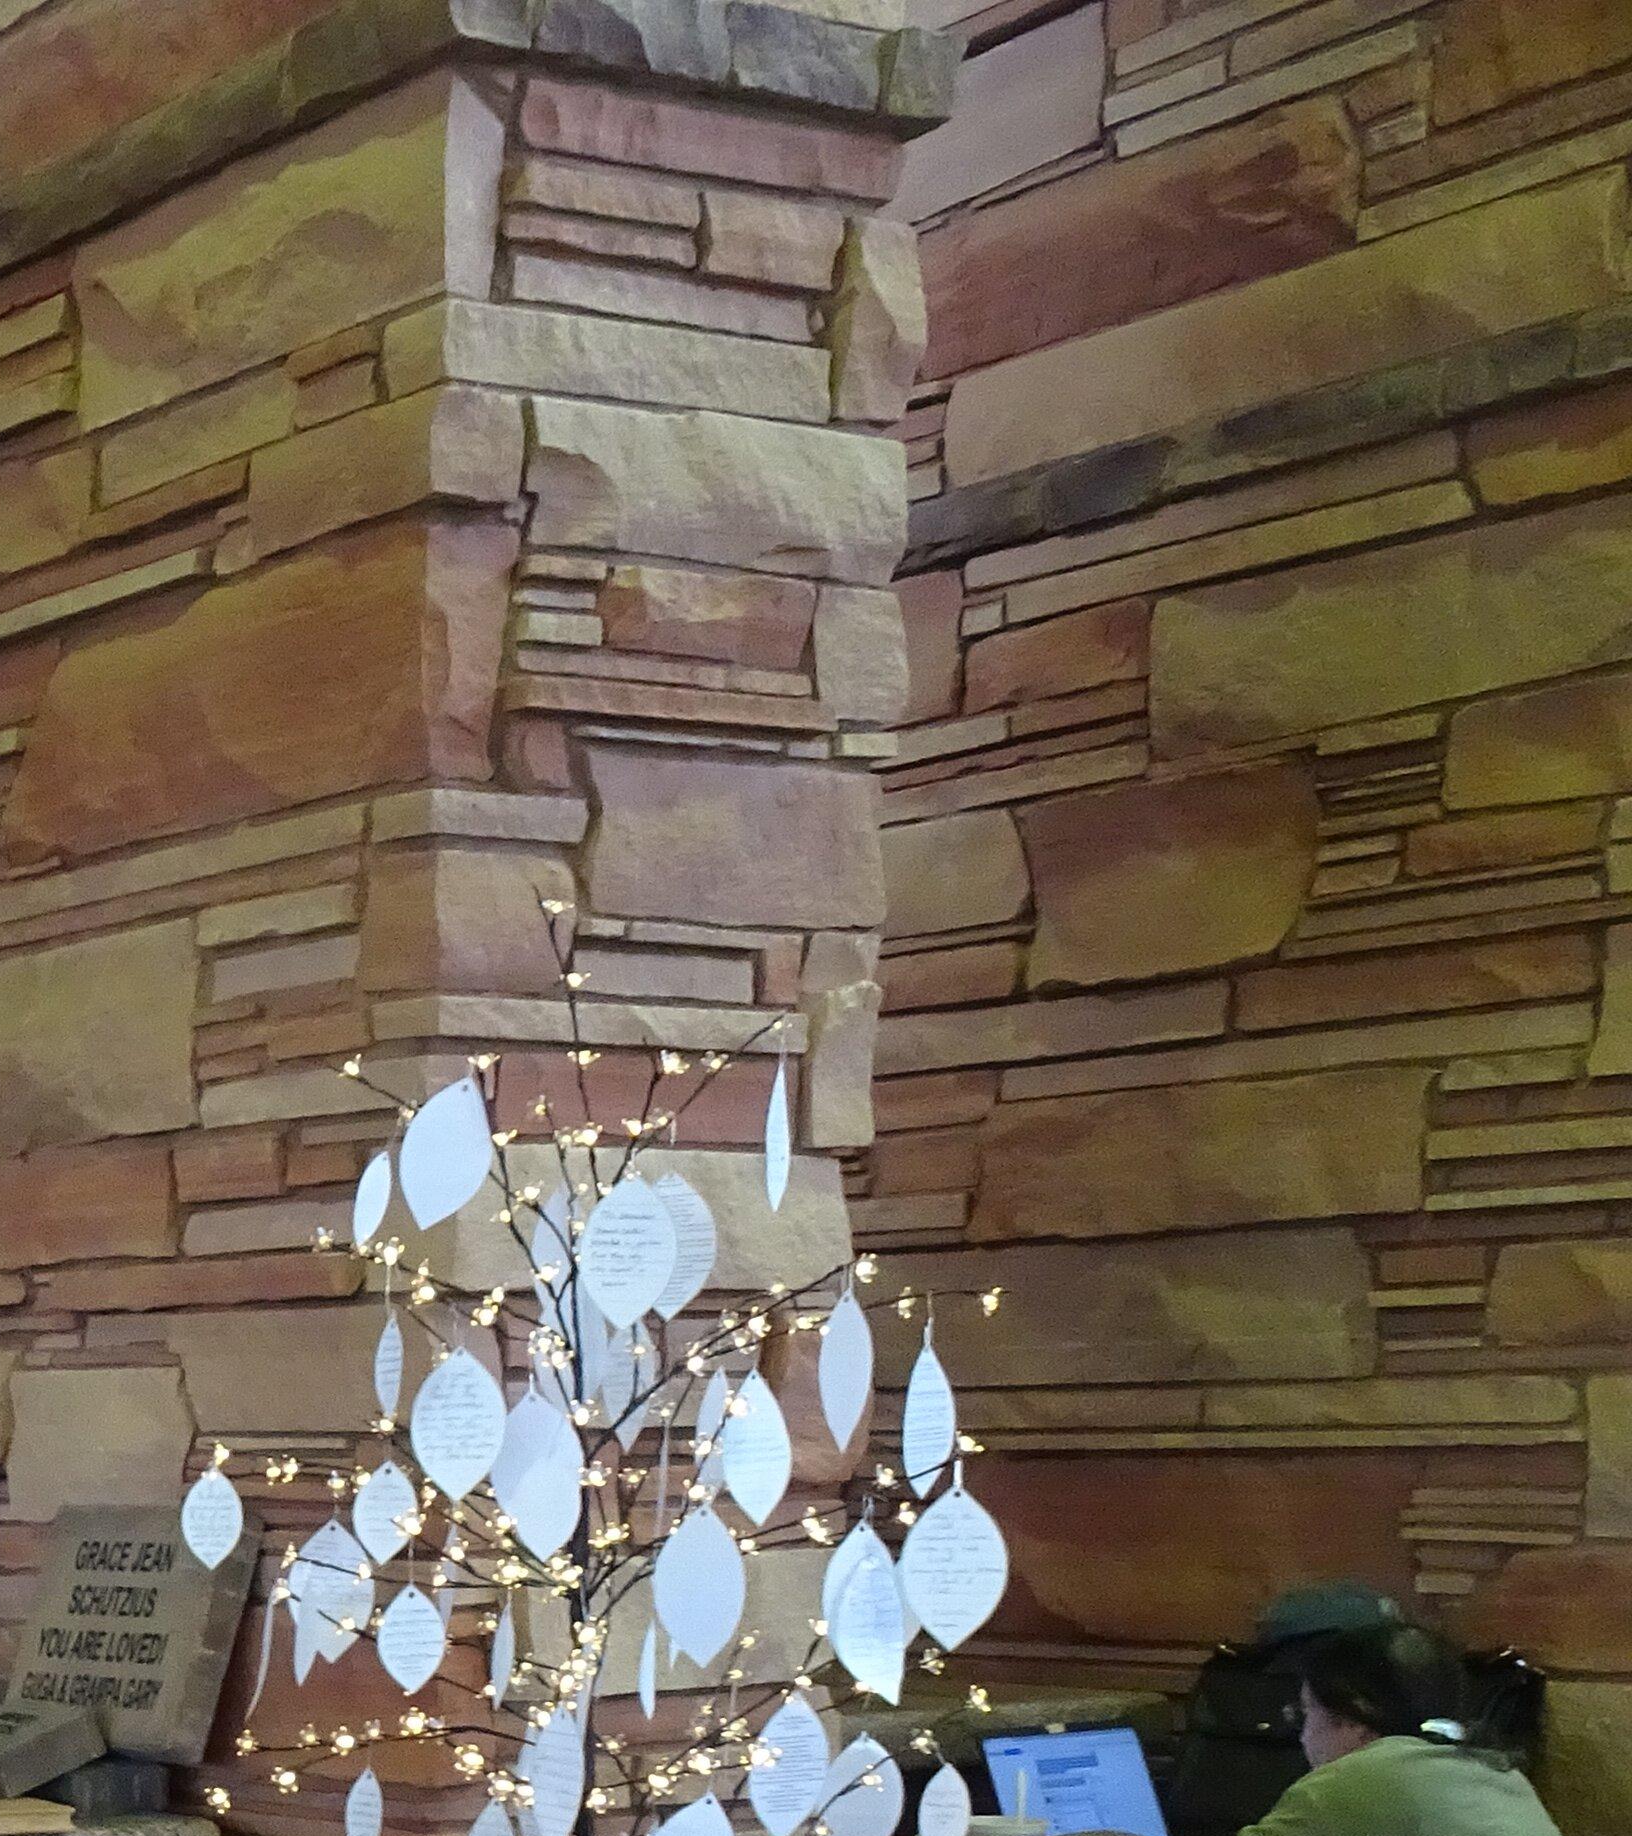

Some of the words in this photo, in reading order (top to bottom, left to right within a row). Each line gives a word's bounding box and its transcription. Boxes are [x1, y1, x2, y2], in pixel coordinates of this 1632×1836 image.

[75, 1541, 132, 1571] GRACE
[131, 1542, 176, 1572] JEAN
[39, 1627, 71, 1659] YOU
[70, 1630, 108, 1662] ARE
